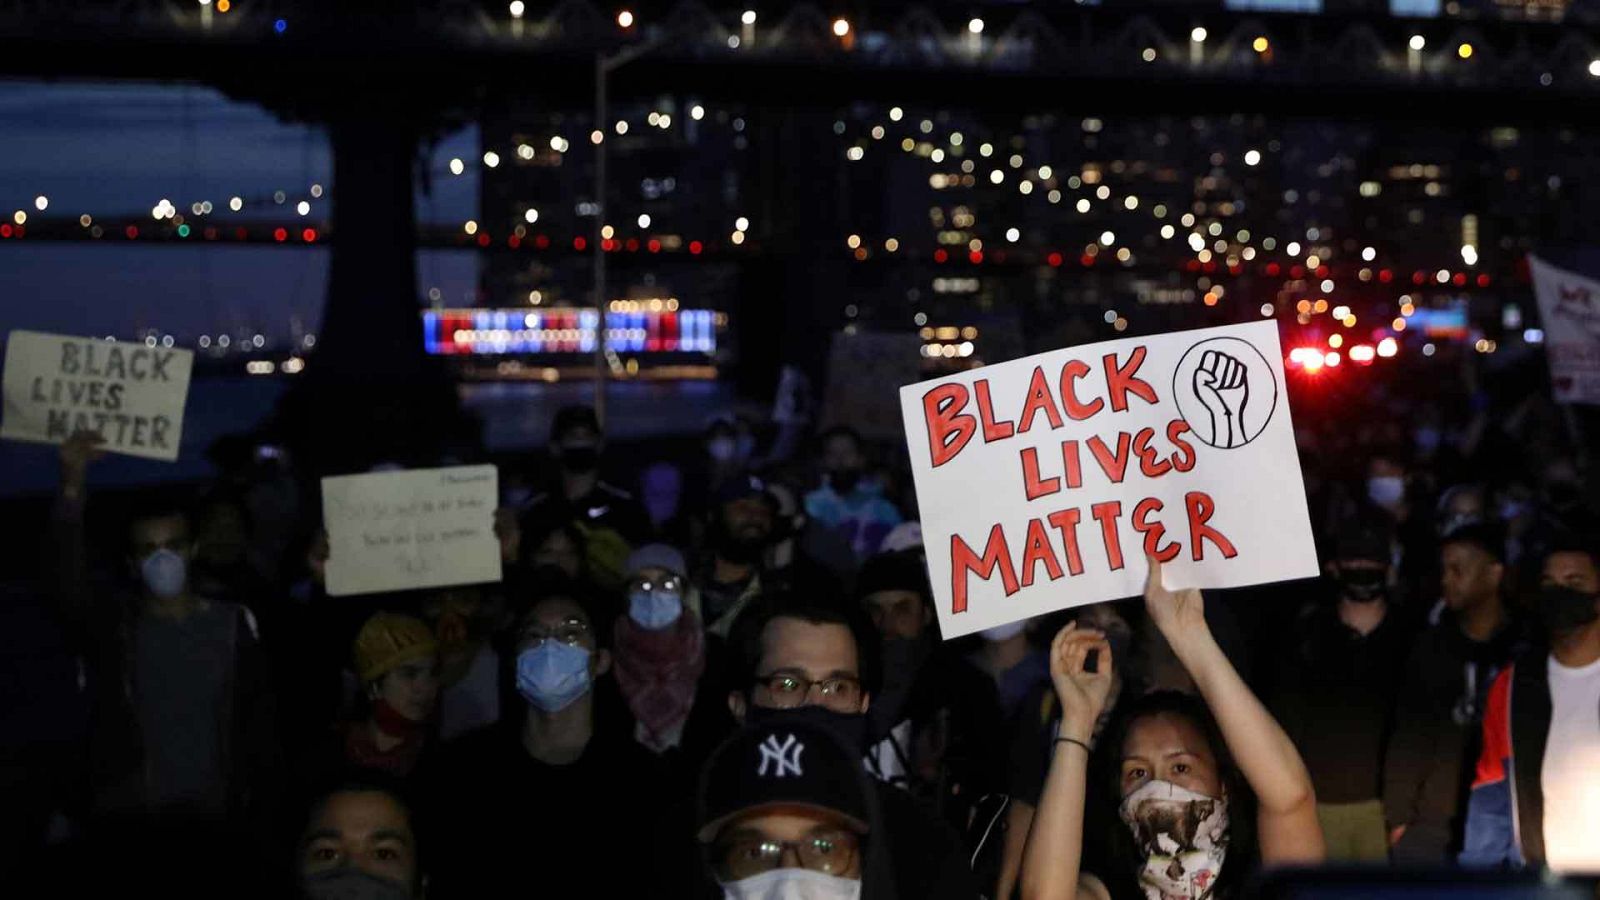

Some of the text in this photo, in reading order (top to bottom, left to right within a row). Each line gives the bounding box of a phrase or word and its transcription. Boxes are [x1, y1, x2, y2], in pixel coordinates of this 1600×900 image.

[31, 376, 125, 410] LIVES
[61, 341, 174, 383] BLACK
[922, 345, 1158, 468] BLACK
[1020, 419, 1196, 501] LIVES
[951, 491, 1238, 615] MATTER
[758, 734, 804, 777] NY
